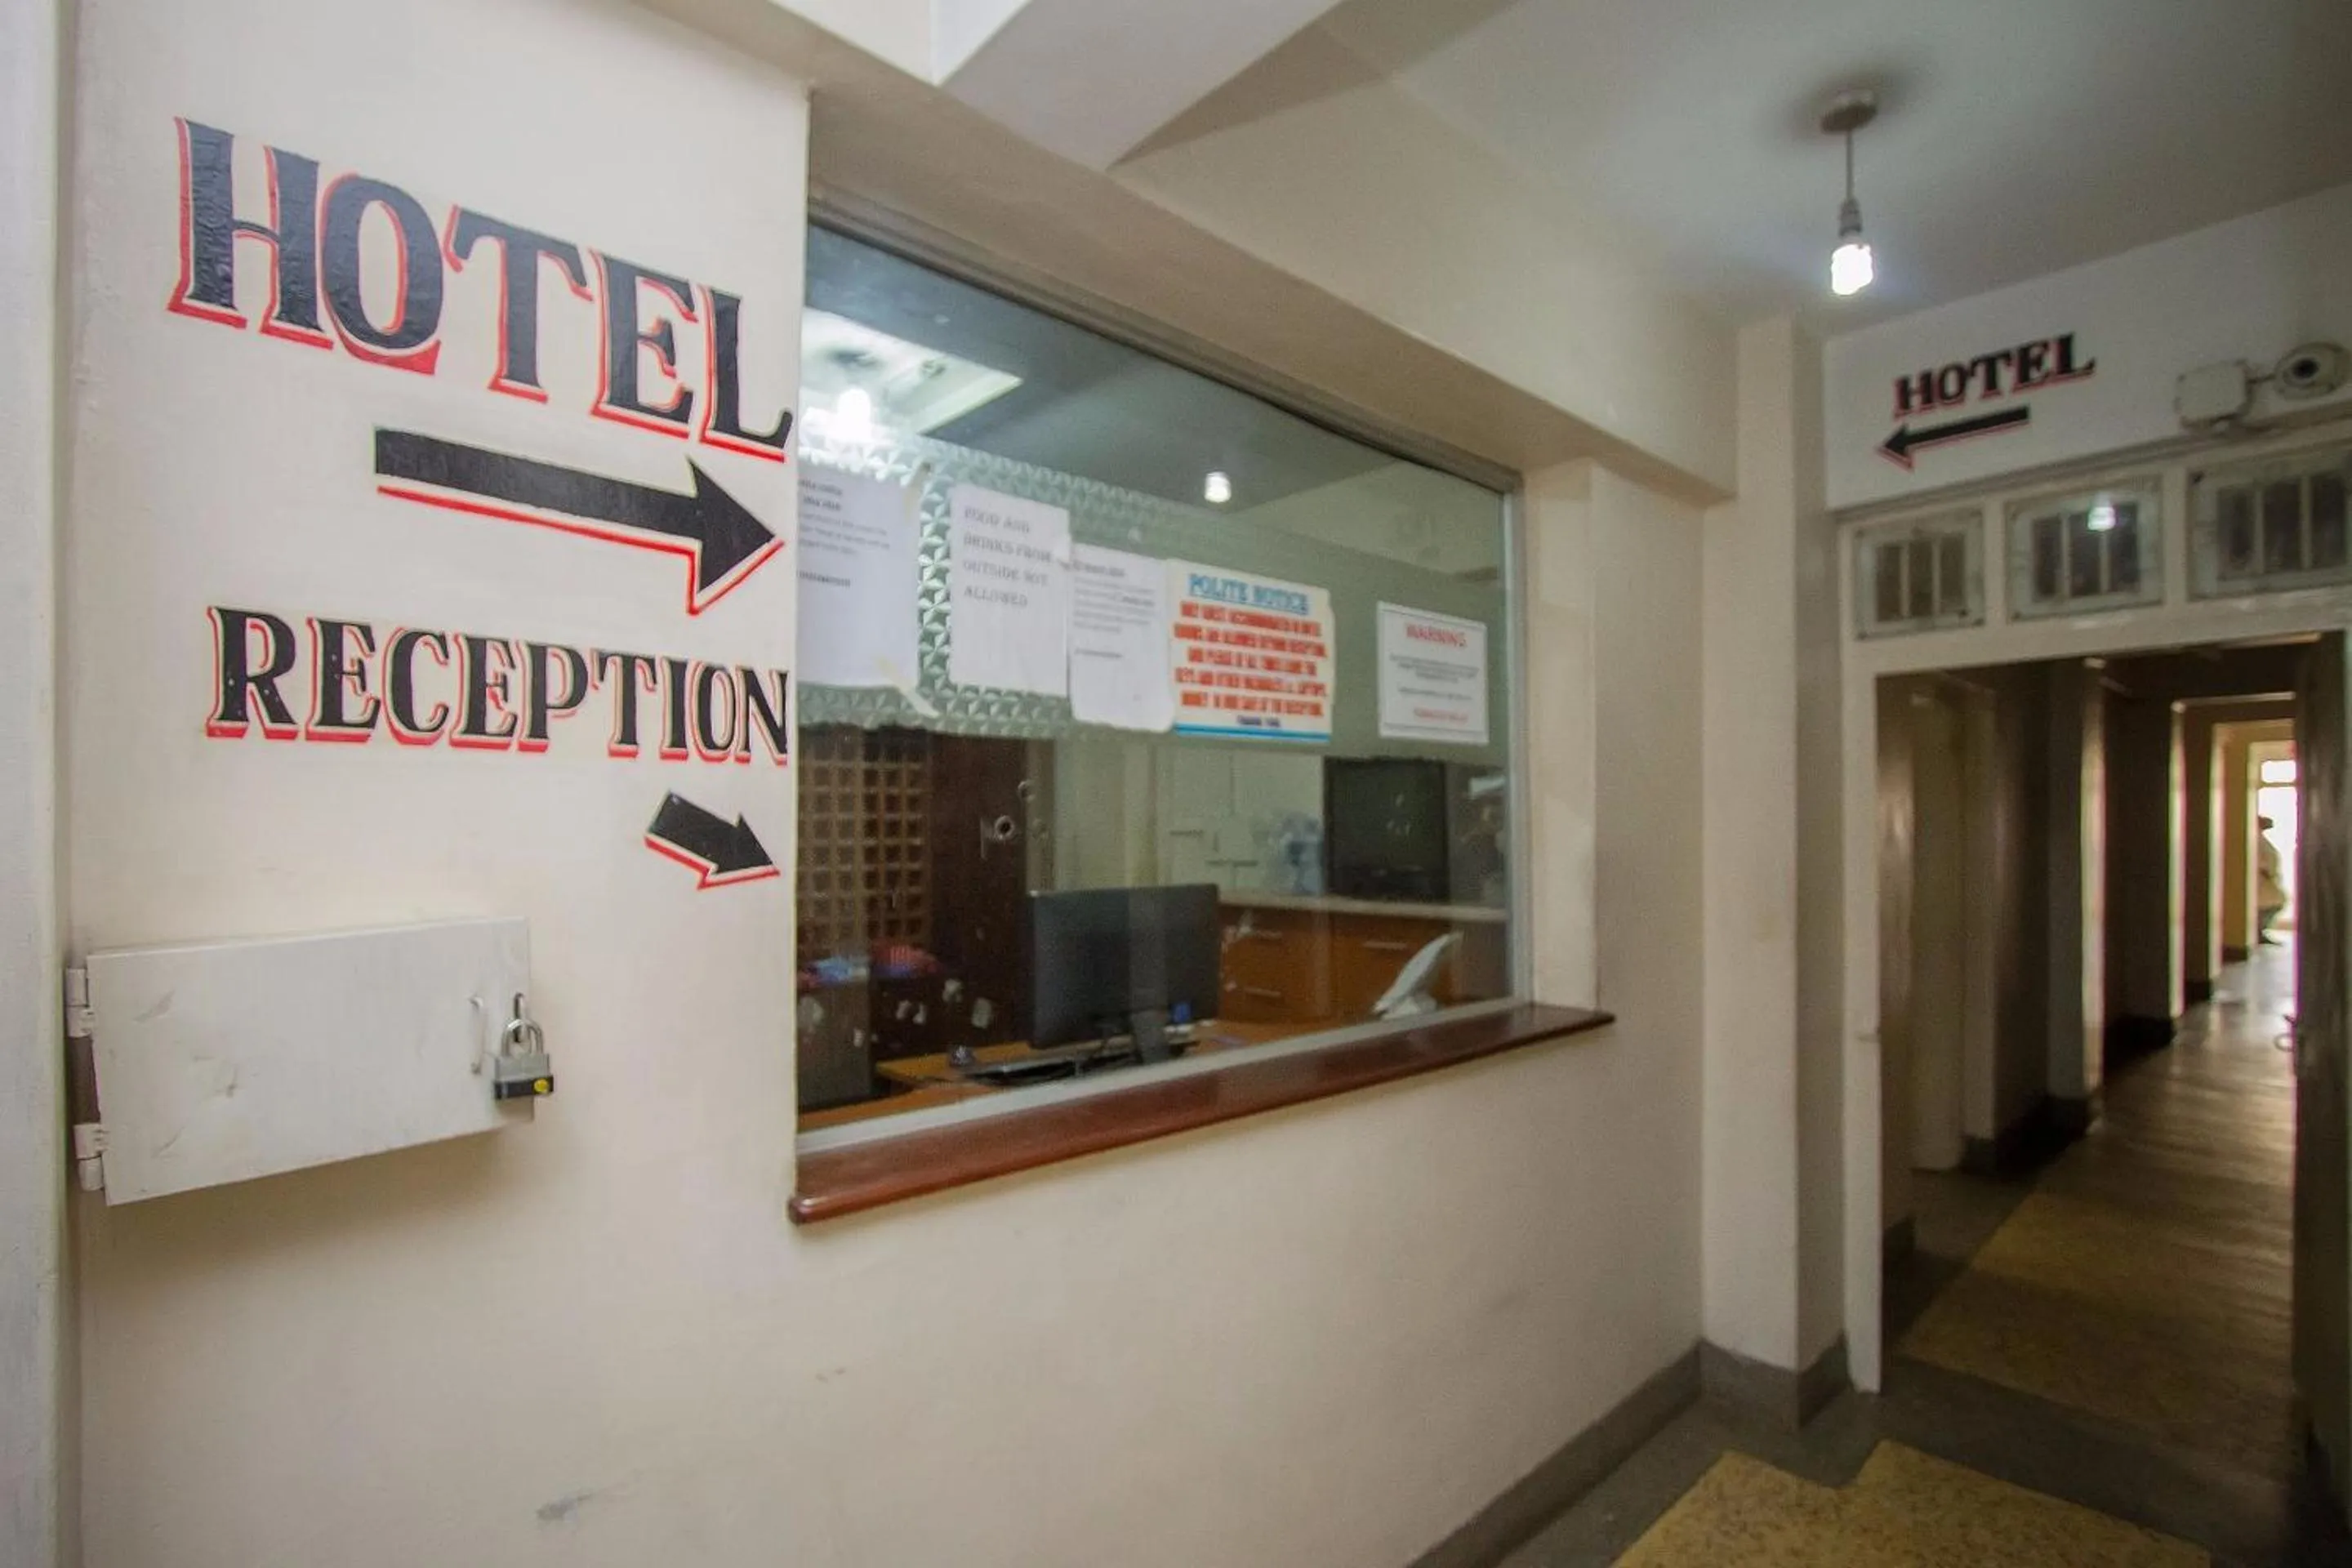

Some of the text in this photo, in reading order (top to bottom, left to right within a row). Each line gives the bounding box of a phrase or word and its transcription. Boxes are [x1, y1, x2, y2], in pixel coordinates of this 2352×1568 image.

[168, 117, 794, 462] HOTEL
[1894, 332, 2096, 421] HOTEL
[964, 586, 1027, 607] ALLOWED
[205, 605, 788, 766] RECEPTION
